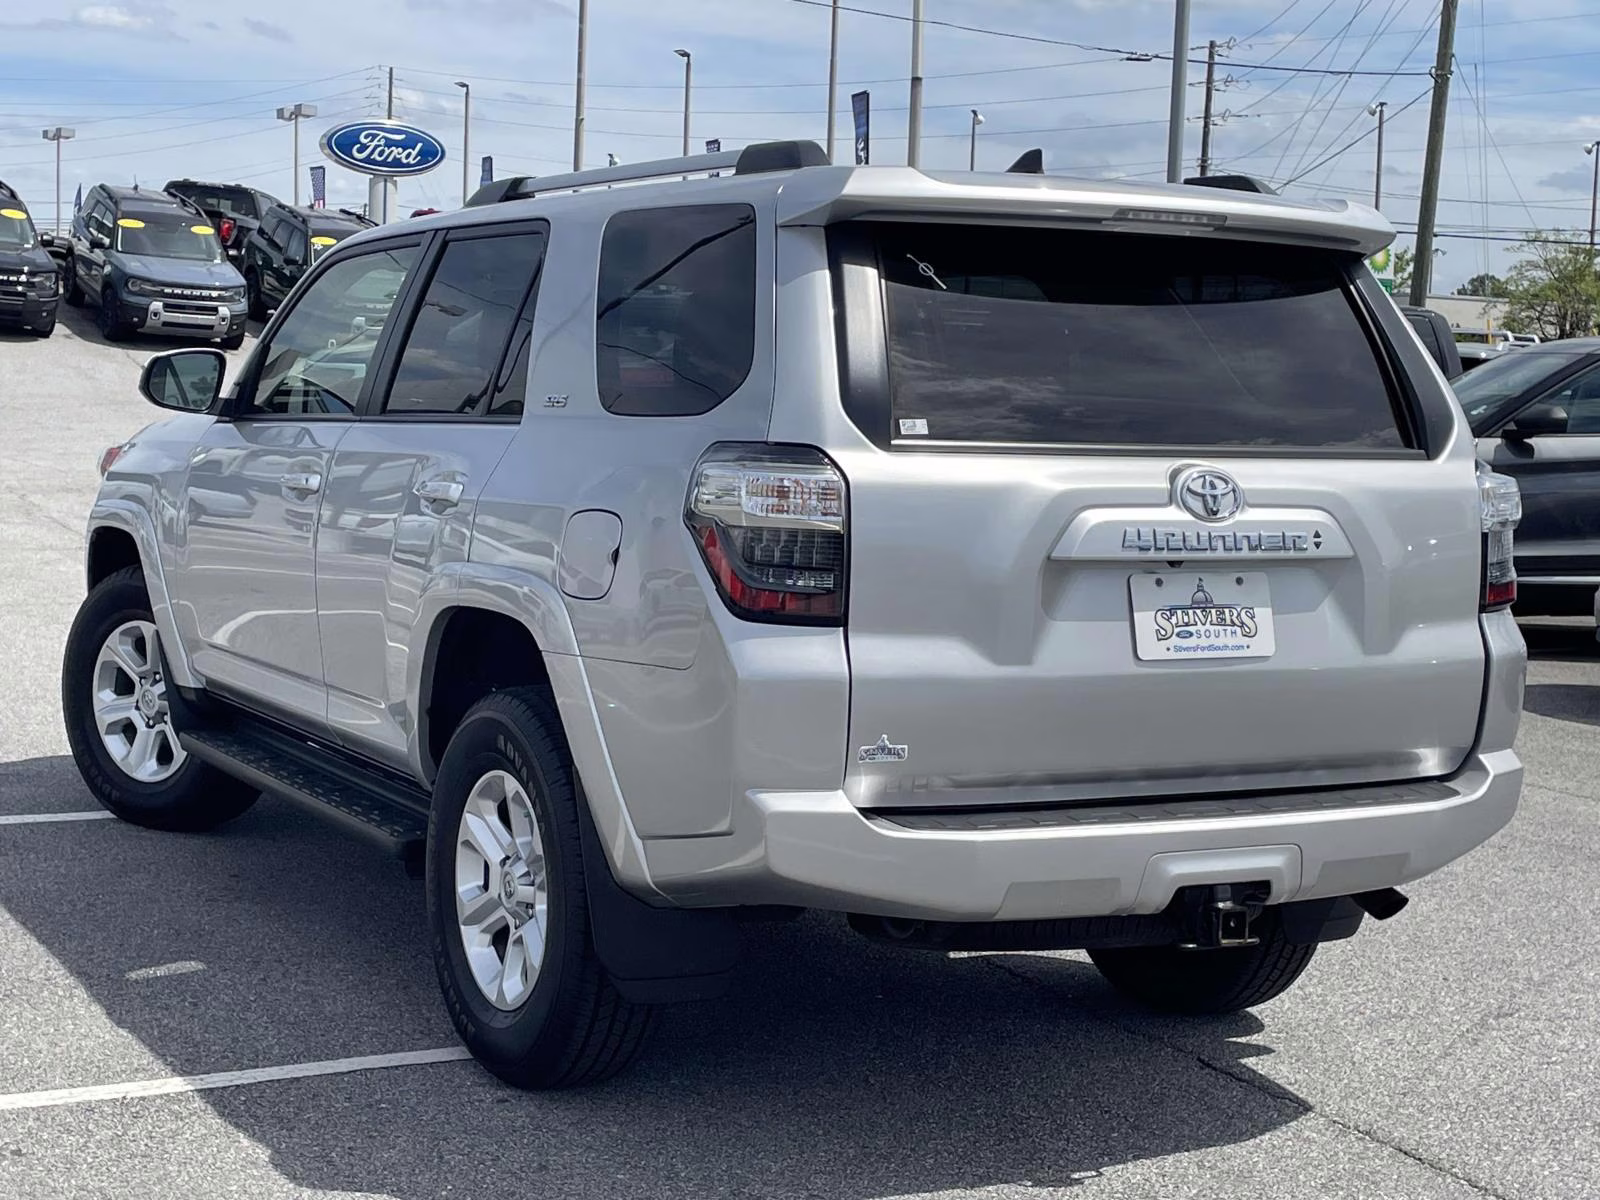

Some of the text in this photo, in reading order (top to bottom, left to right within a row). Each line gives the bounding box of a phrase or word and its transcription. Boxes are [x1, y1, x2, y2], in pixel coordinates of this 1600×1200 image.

[352, 130, 423, 164] Ford
[1155, 607, 1257, 642] STIVERS
[1196, 629, 1238, 639] SOUTH
